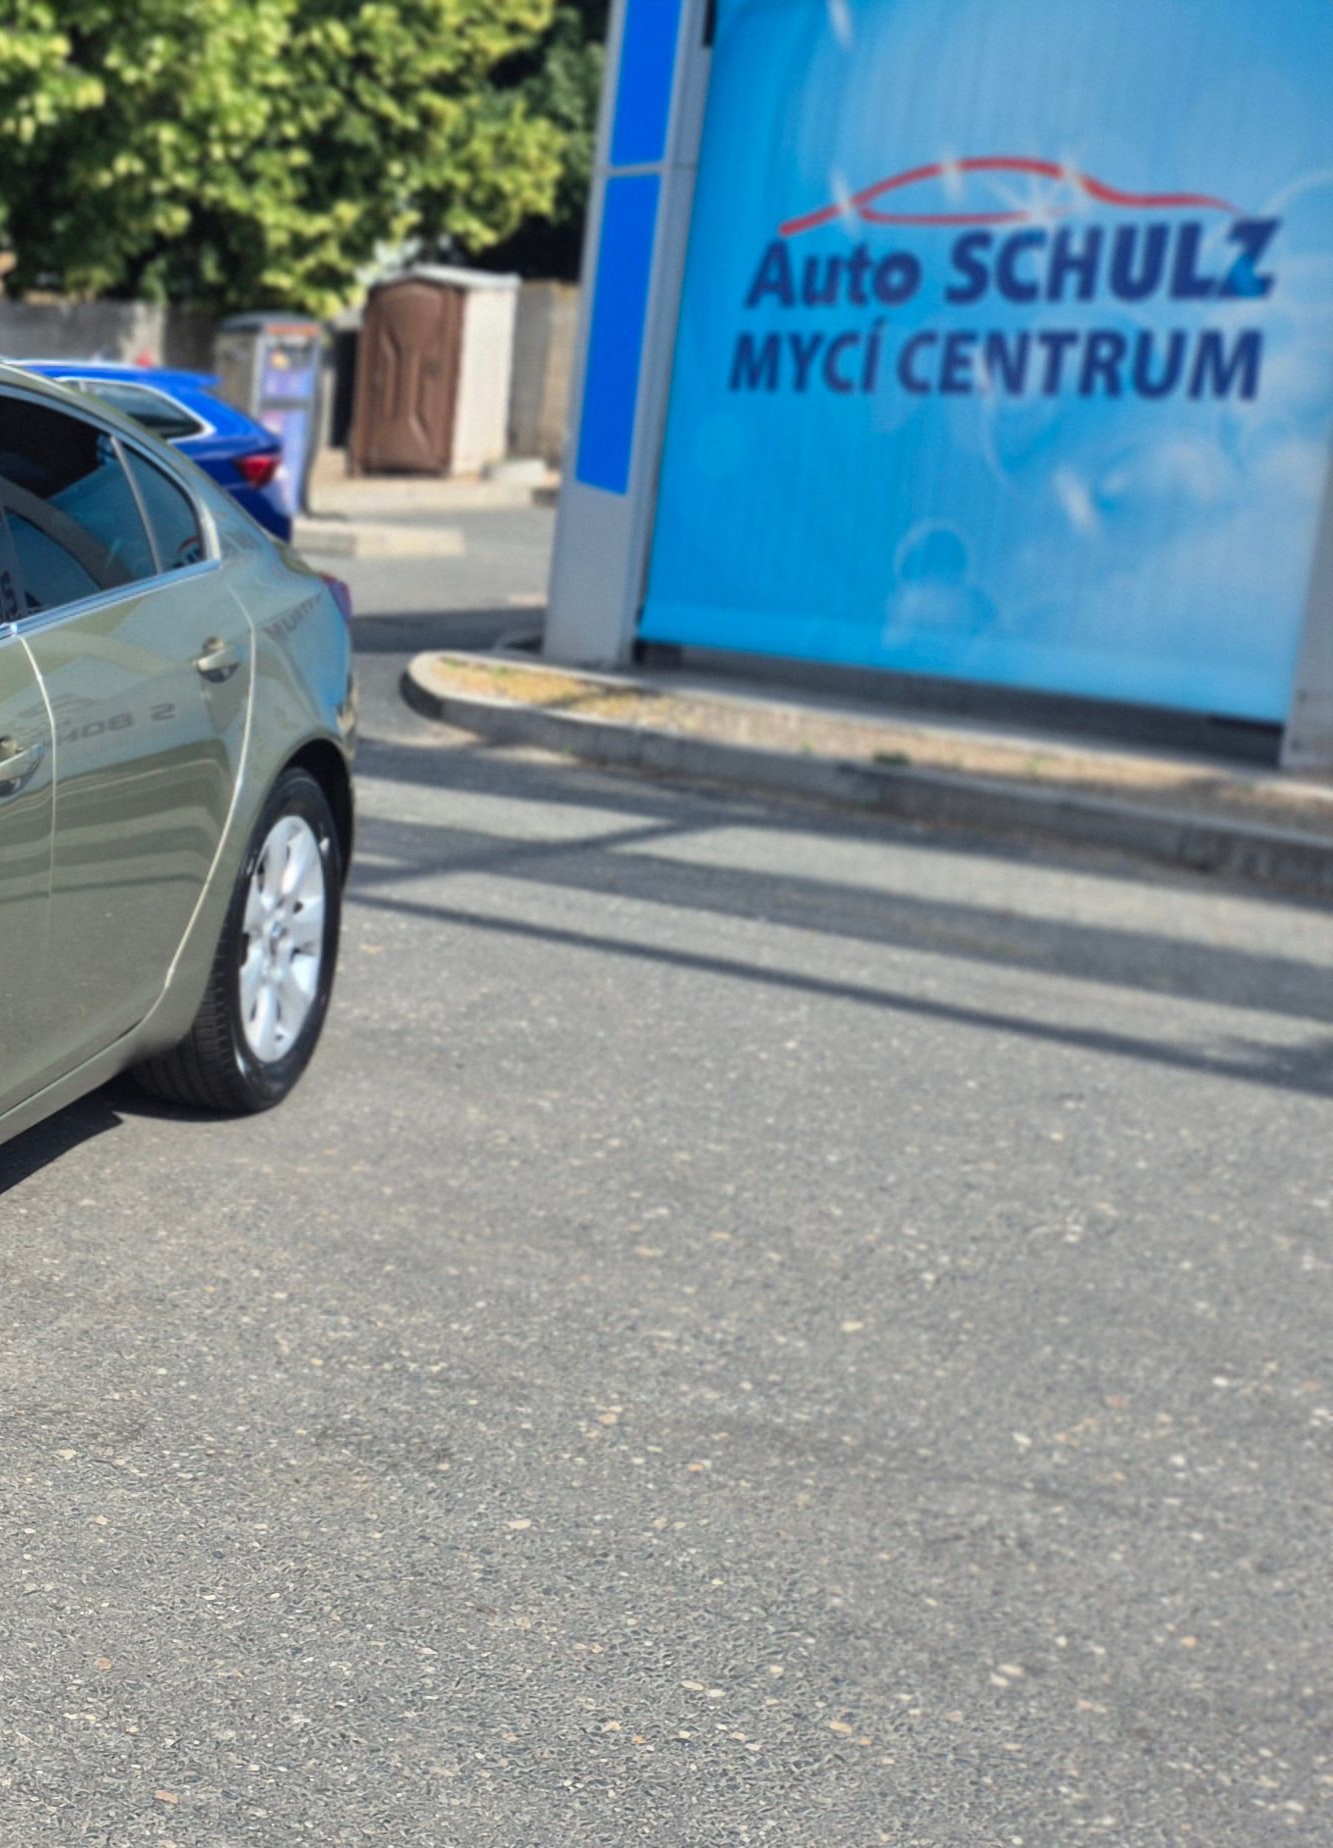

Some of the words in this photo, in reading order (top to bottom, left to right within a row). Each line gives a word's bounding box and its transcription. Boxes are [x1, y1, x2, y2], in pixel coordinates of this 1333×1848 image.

[744, 238, 922, 309] Auto
[944, 216, 1281, 304] SCHULZ
[728, 316, 886, 394] MYCÍ
[896, 328, 1264, 401] CENTRUM
